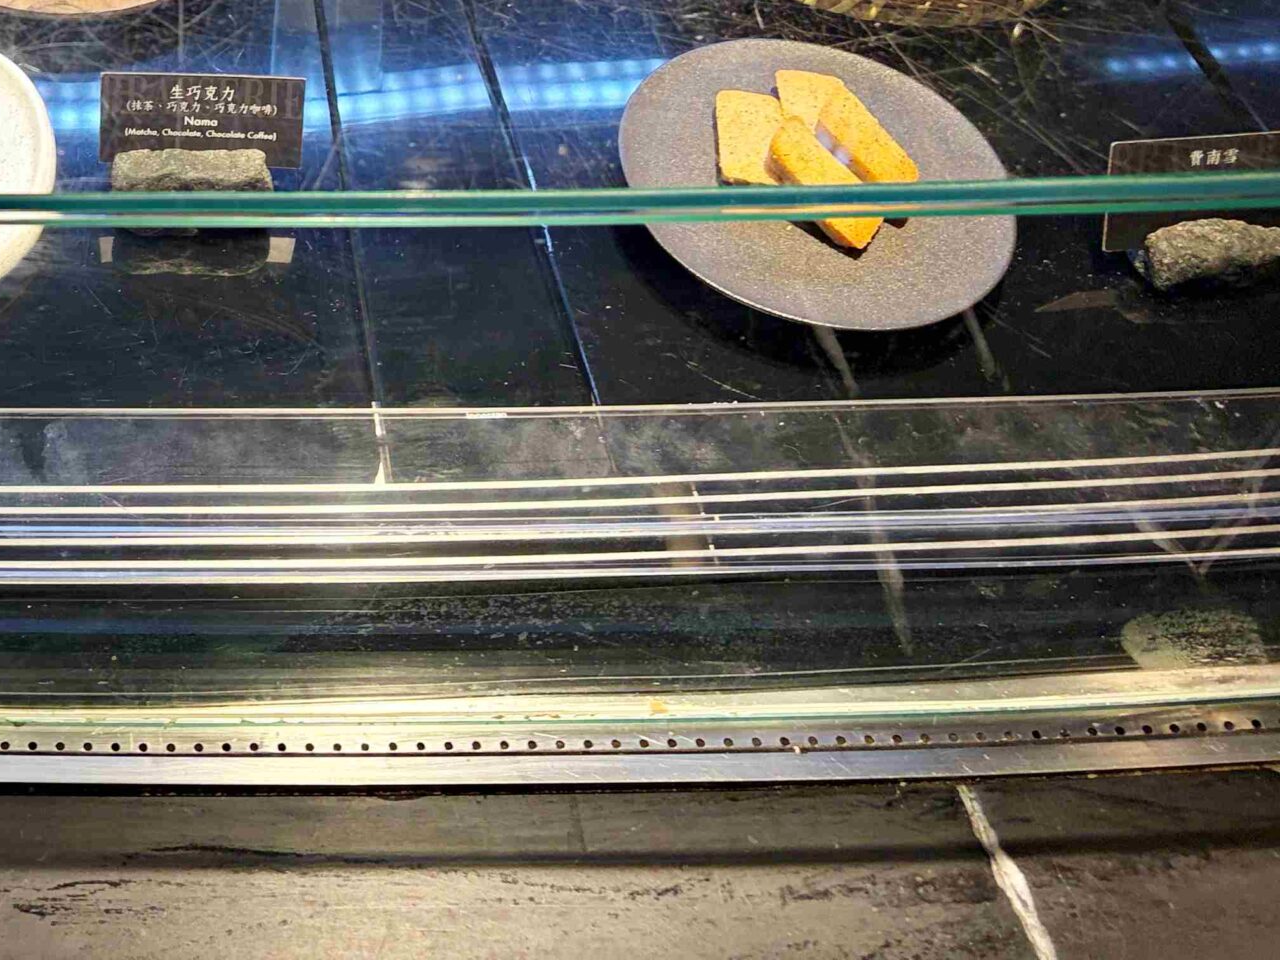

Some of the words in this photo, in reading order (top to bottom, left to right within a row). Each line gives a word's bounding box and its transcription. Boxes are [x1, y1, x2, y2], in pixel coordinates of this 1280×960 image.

[169, 85, 235, 102] 生巧克力
[183, 116, 218, 127] Nama
[124, 128, 160, 138] (Matcha,
[162, 128, 204, 139] Chocolate,
[206, 129, 245, 139] Chocolate
[247, 131, 277, 142] Coffee)
[1189, 148, 1240, 167] 費南雪
